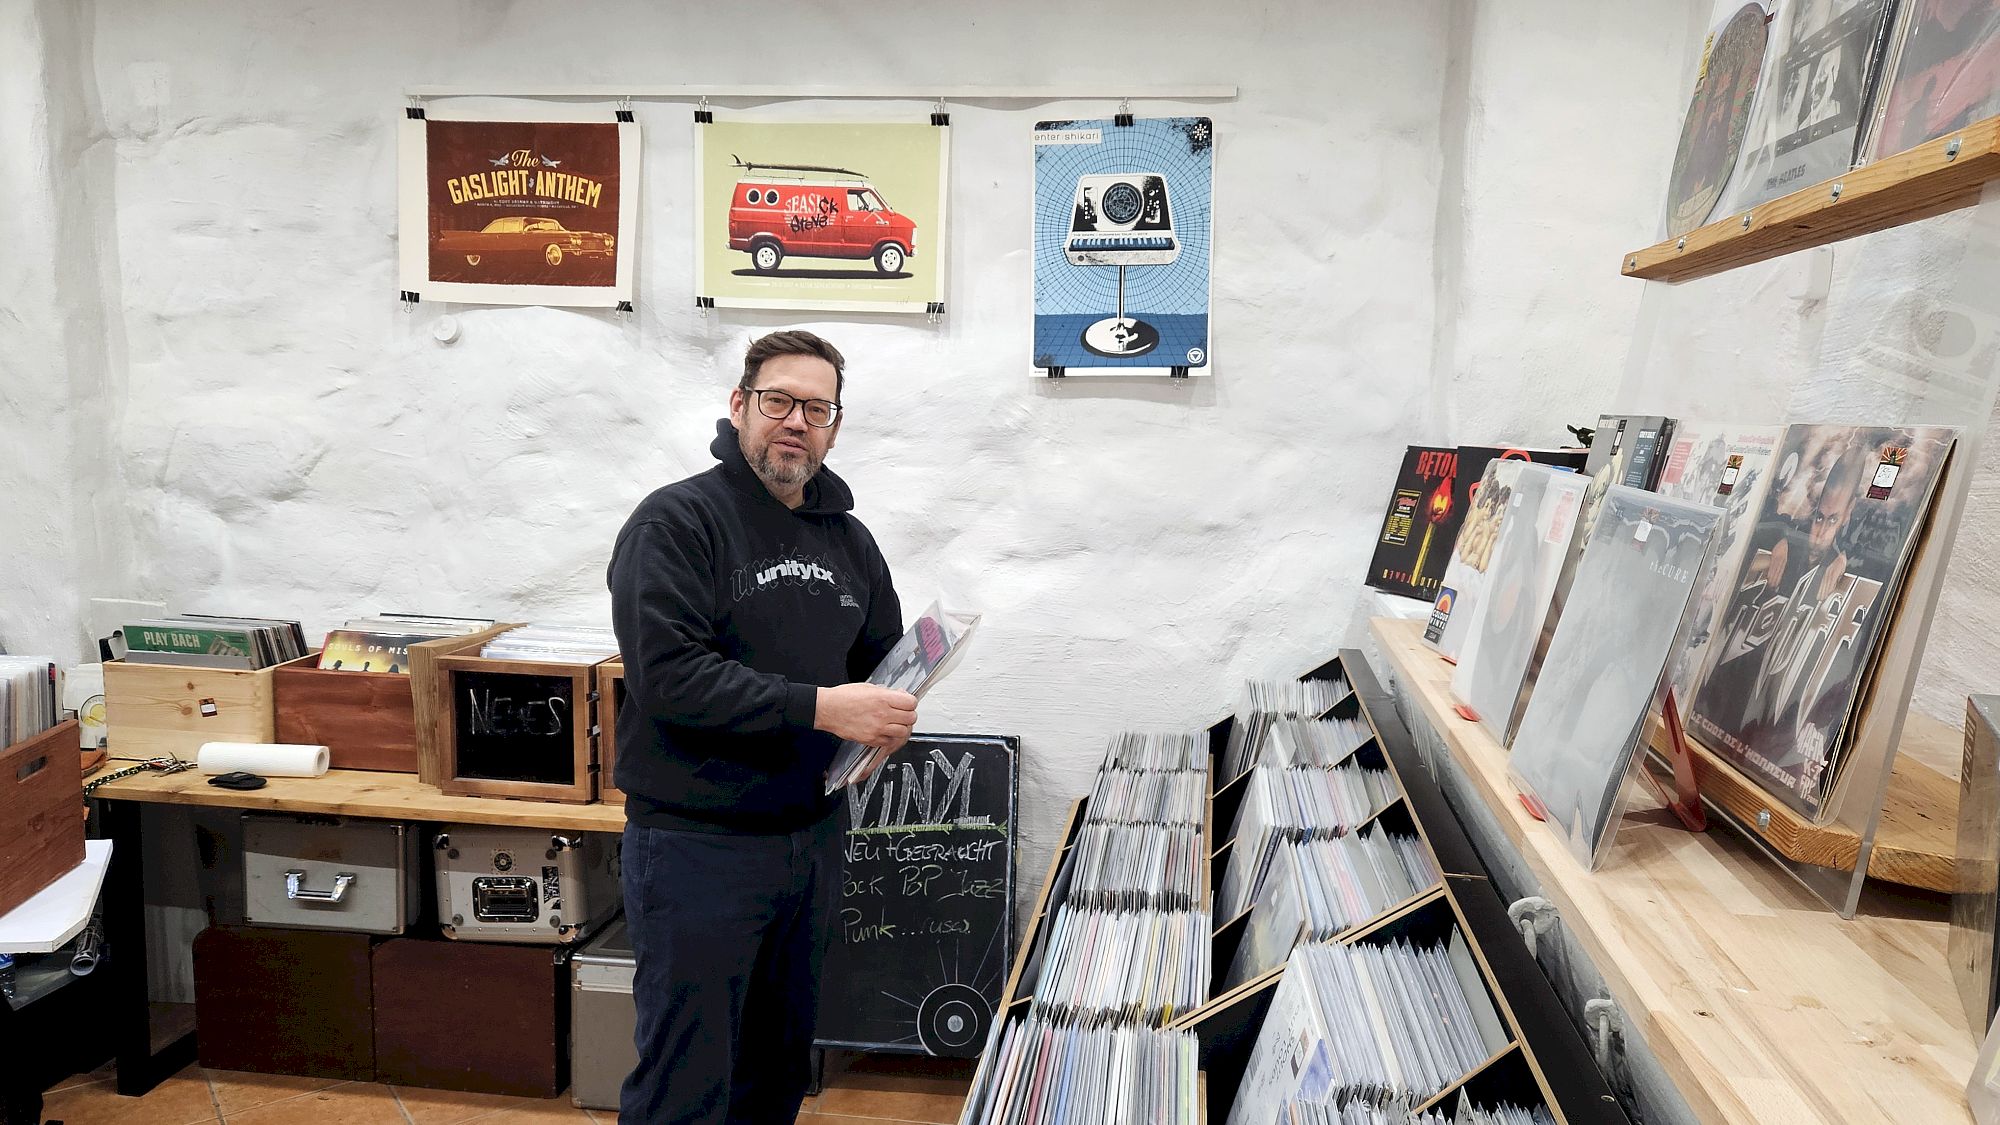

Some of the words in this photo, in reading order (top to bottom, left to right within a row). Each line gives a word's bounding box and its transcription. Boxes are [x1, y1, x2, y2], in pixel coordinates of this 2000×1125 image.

[1034, 133, 1060, 141] enter
[1064, 132, 1099, 141] shikari
[511, 149, 540, 168] The
[447, 169, 529, 206] GASLIGHT
[535, 170, 602, 209] ANTHEM
[790, 212, 829, 234] Steve
[756, 559, 835, 585] unitytx
[143, 631, 169, 646] PLAY
[170, 633, 201, 648] BACH
[328, 642, 361, 652] SOULS
[368, 645, 382, 653] OF
[1690, 710, 1703, 724] LE
[1702, 717, 1725, 739] CODE
[1724, 733, 1738, 749] DE
[845, 834, 881, 864] NEU
